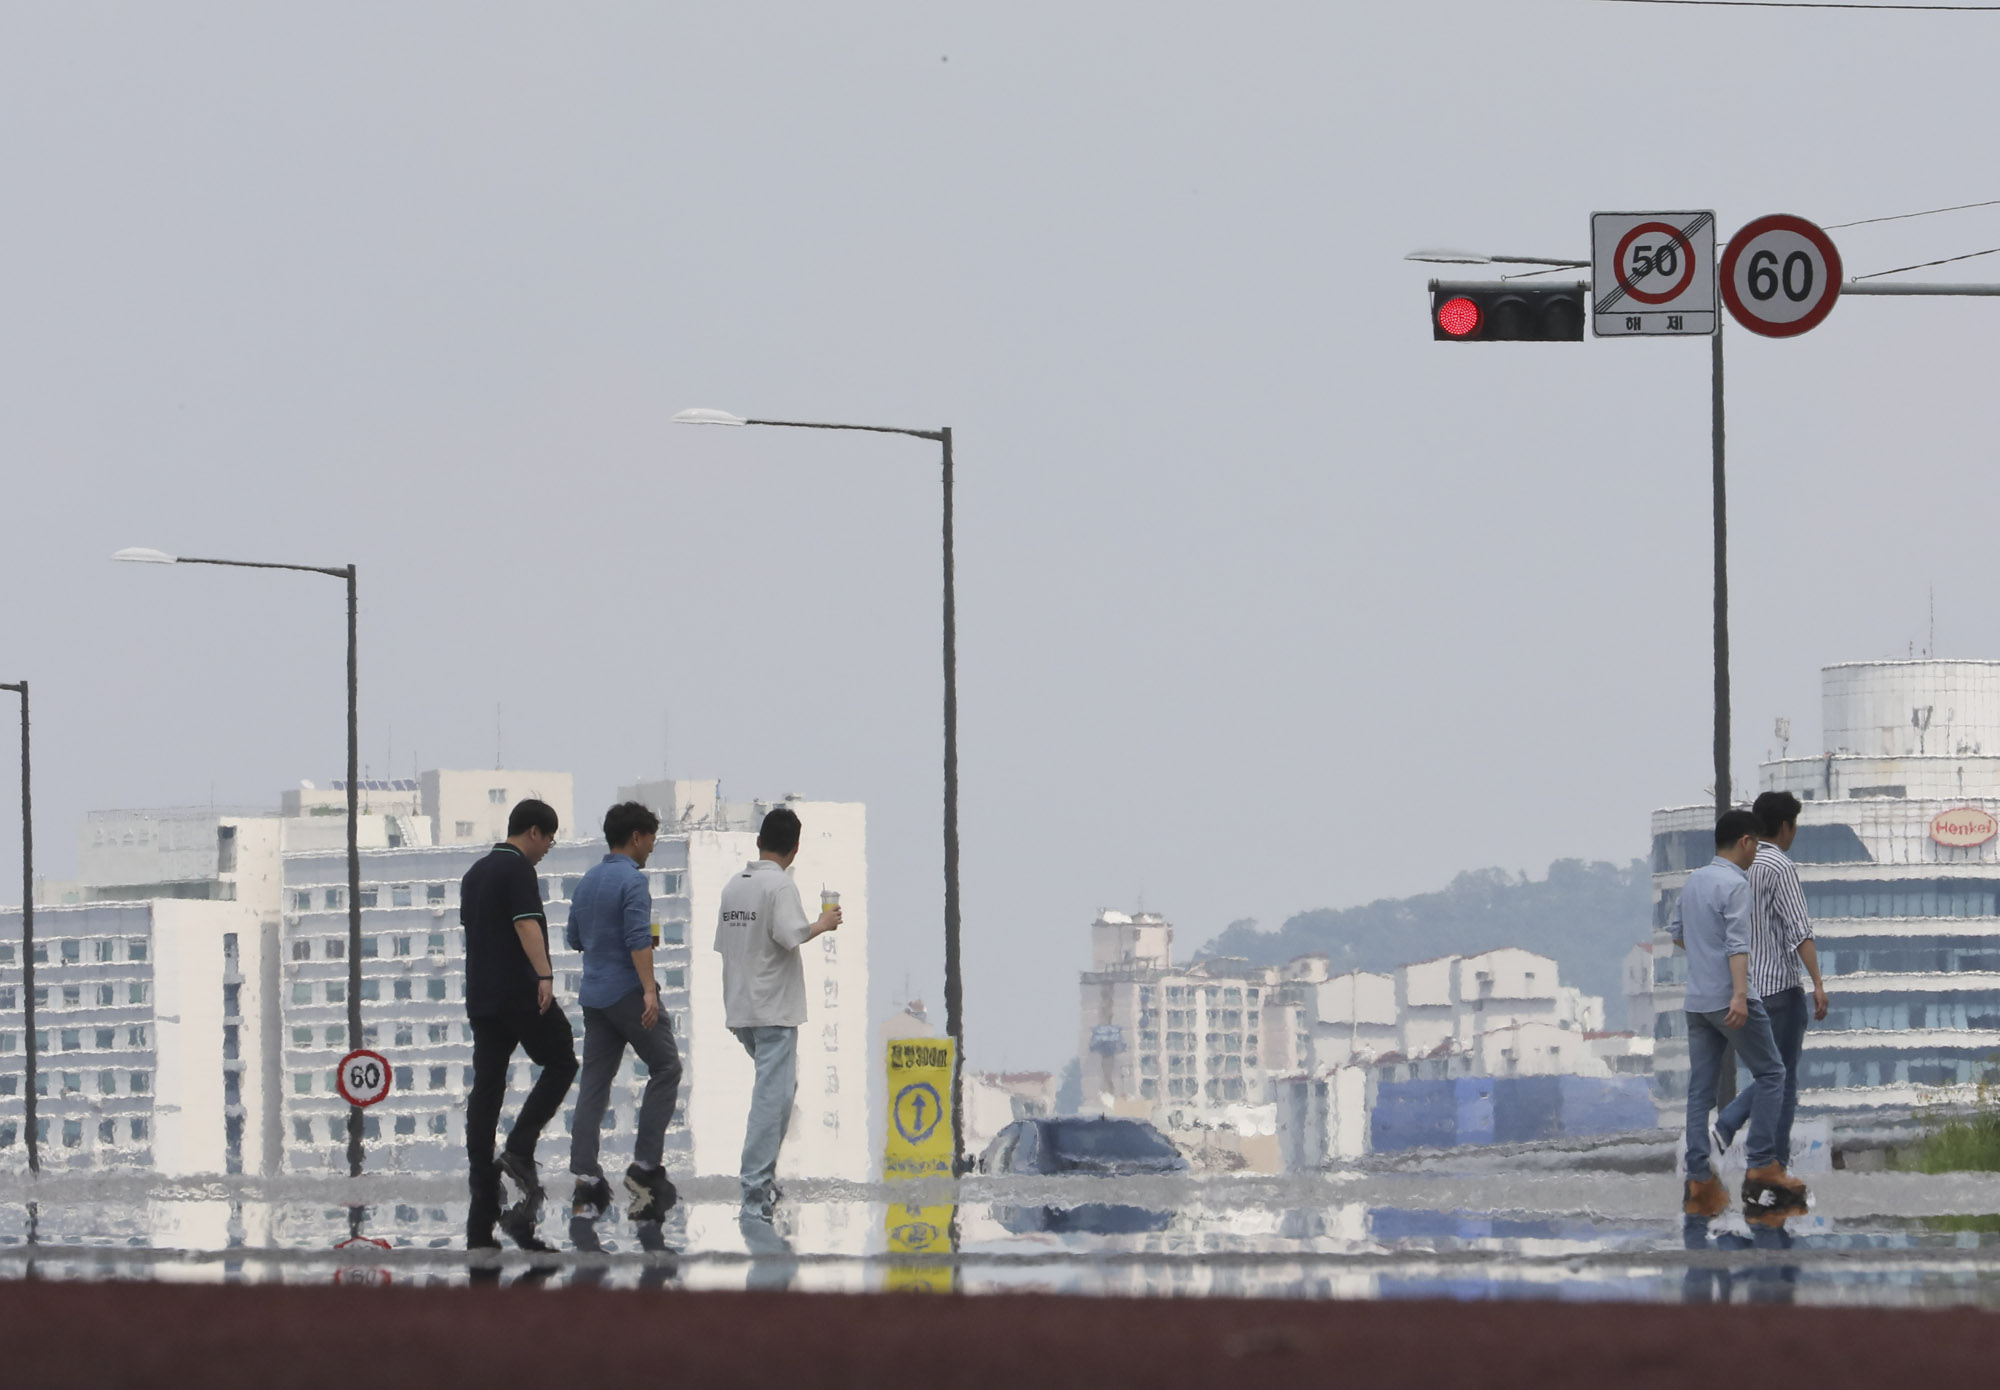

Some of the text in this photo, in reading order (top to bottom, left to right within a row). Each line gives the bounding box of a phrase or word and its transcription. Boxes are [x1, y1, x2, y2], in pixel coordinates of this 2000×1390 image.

[1632, 245, 1677, 276] 50
[1747, 250, 1813, 302] 60
[1936, 819, 1992, 835] Henkel
[351, 1063, 380, 1089] 60
